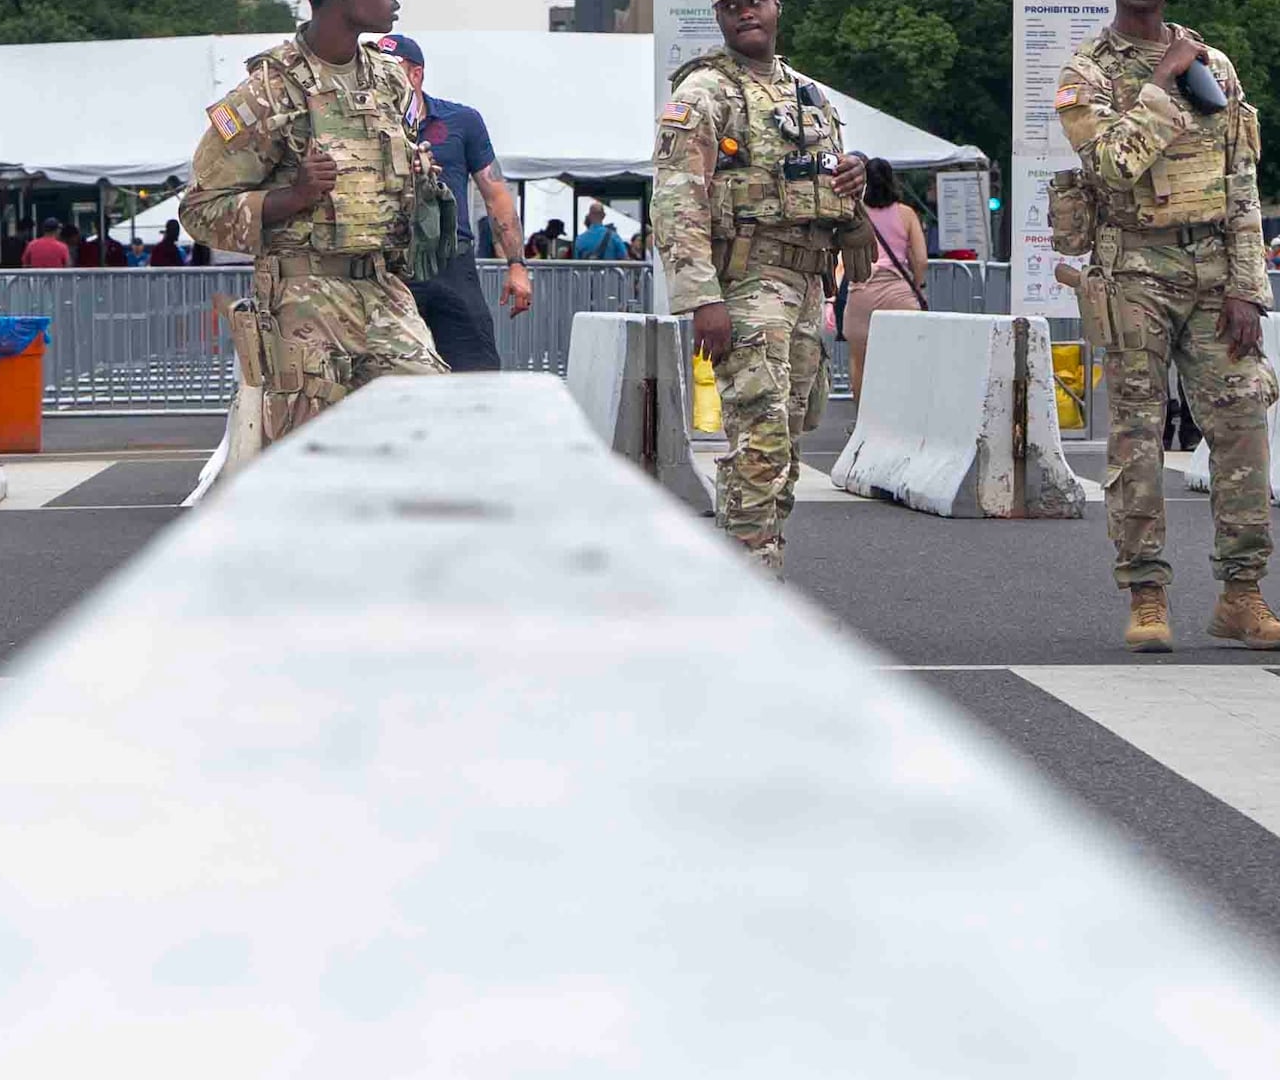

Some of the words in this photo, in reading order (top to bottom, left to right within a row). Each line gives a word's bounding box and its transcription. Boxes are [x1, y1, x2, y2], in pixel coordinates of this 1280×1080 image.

[669, 7, 713, 16] PERMITTE
[1024, 6, 1080, 14] PROHIBITED
[1082, 6, 1109, 14] ITEMS
